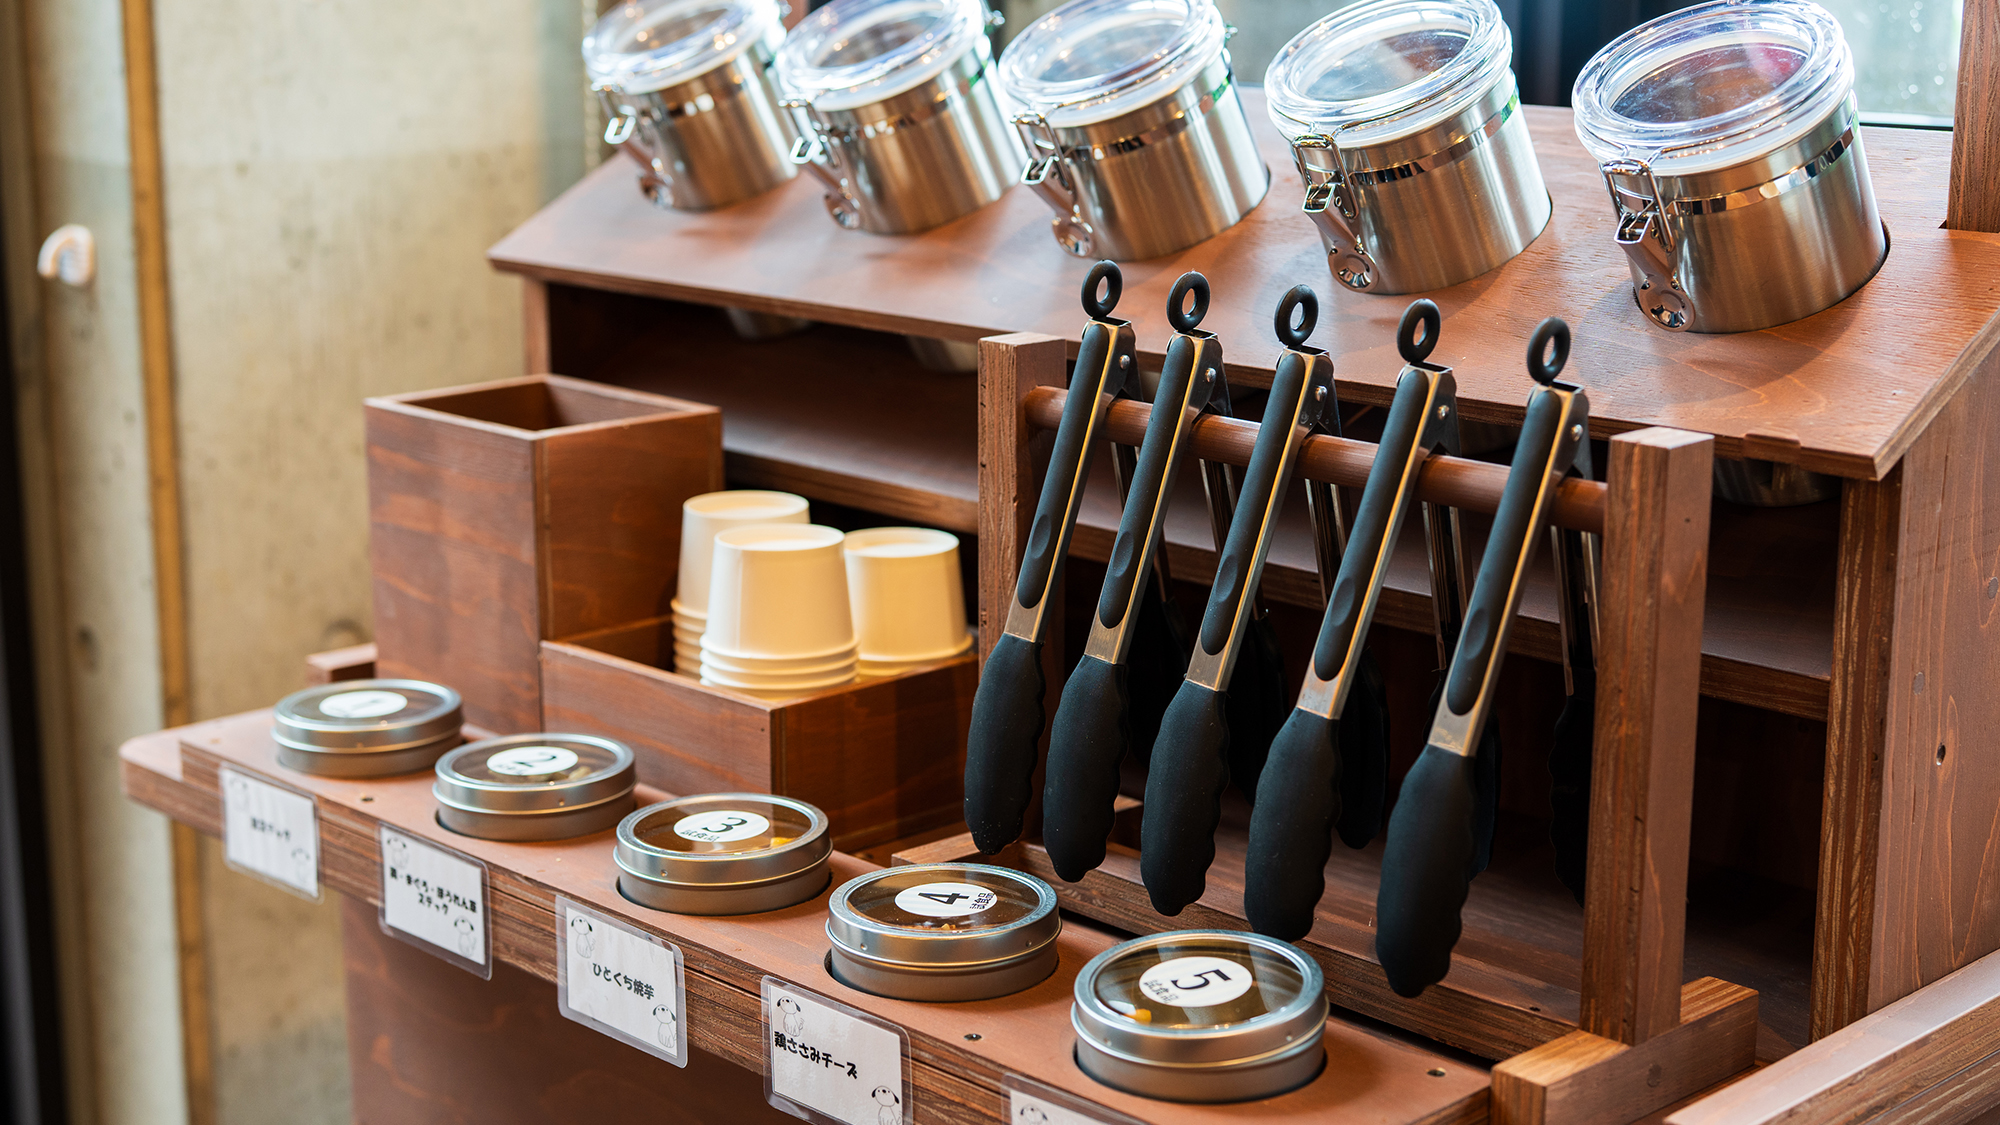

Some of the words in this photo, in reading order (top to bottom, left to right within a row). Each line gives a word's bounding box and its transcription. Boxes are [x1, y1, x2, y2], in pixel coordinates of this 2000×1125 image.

[514, 751, 556, 768] 2
[701, 816, 748, 833] 3
[918, 892, 970, 905] 4
[592, 962, 655, 1000] ひとくち焼芋
[1170, 968, 1232, 991] 5
[774, 1030, 858, 1080] 鶏ささみチーズ
